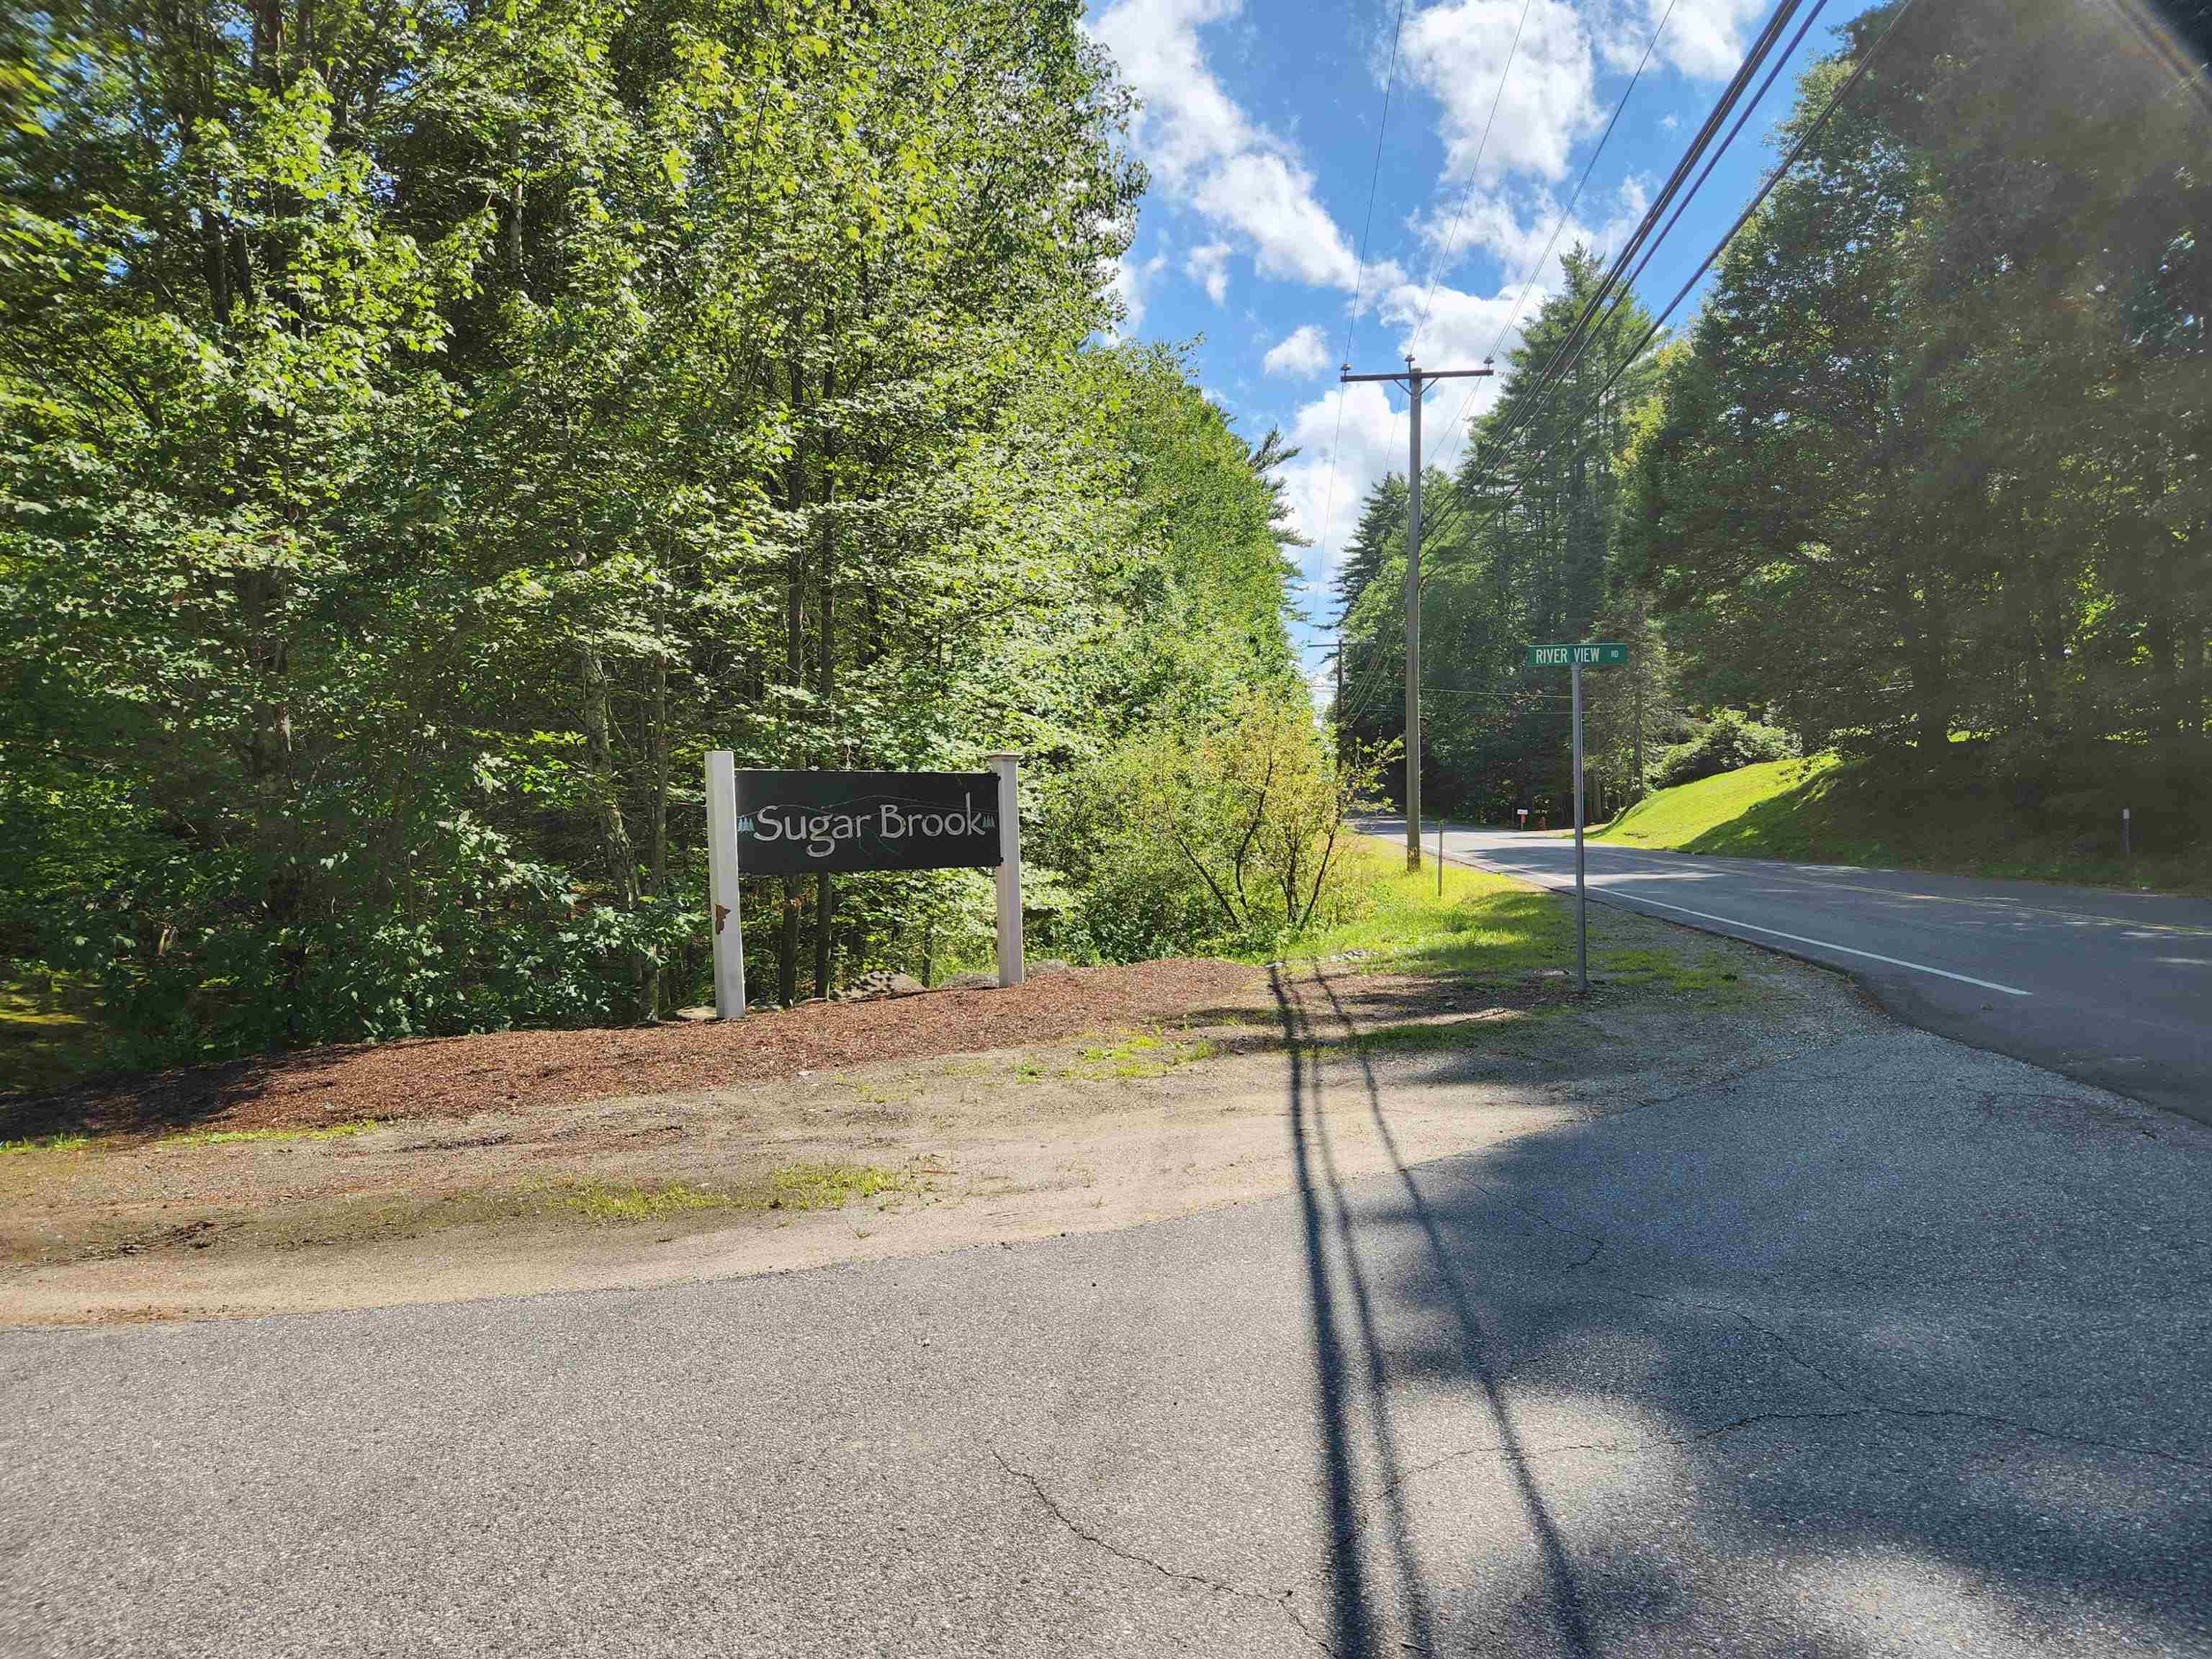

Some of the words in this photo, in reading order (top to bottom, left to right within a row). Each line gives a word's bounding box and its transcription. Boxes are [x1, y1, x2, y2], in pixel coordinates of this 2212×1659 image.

[1536, 649, 1568, 663] RIVER
[1573, 647, 1600, 662] VIEW
[753, 805, 871, 858] Sugar
[878, 791, 986, 839] Brook
